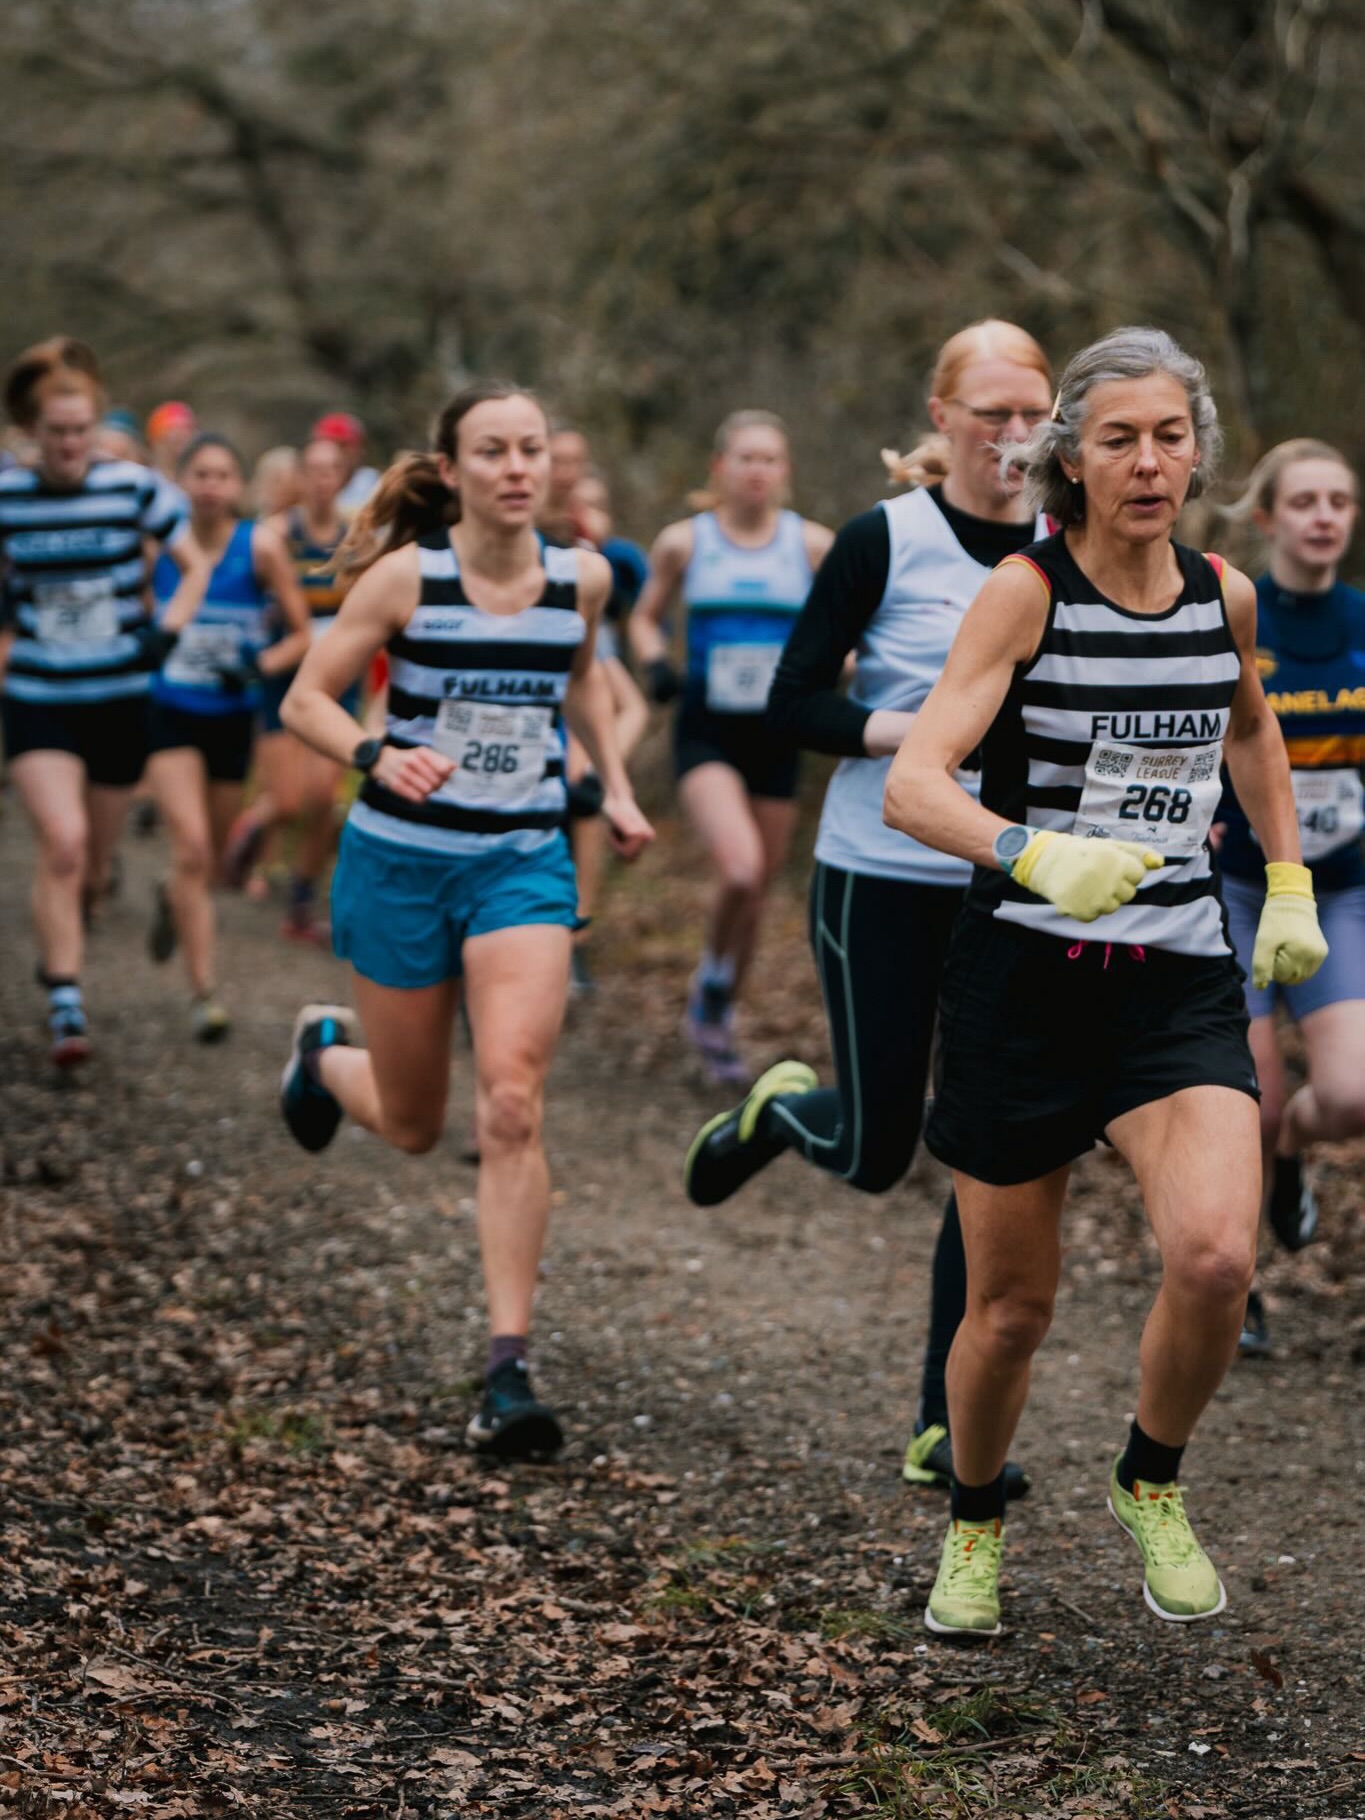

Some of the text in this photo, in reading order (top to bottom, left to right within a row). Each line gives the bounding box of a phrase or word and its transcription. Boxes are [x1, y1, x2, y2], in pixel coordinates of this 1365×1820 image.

[443, 677, 555, 696] FULHAM
[1090, 713, 1221, 740] FULHAM
[461, 740, 519, 774] 286
[1141, 755, 1188, 767] SURREY
[1118, 784, 1193, 825] 268
